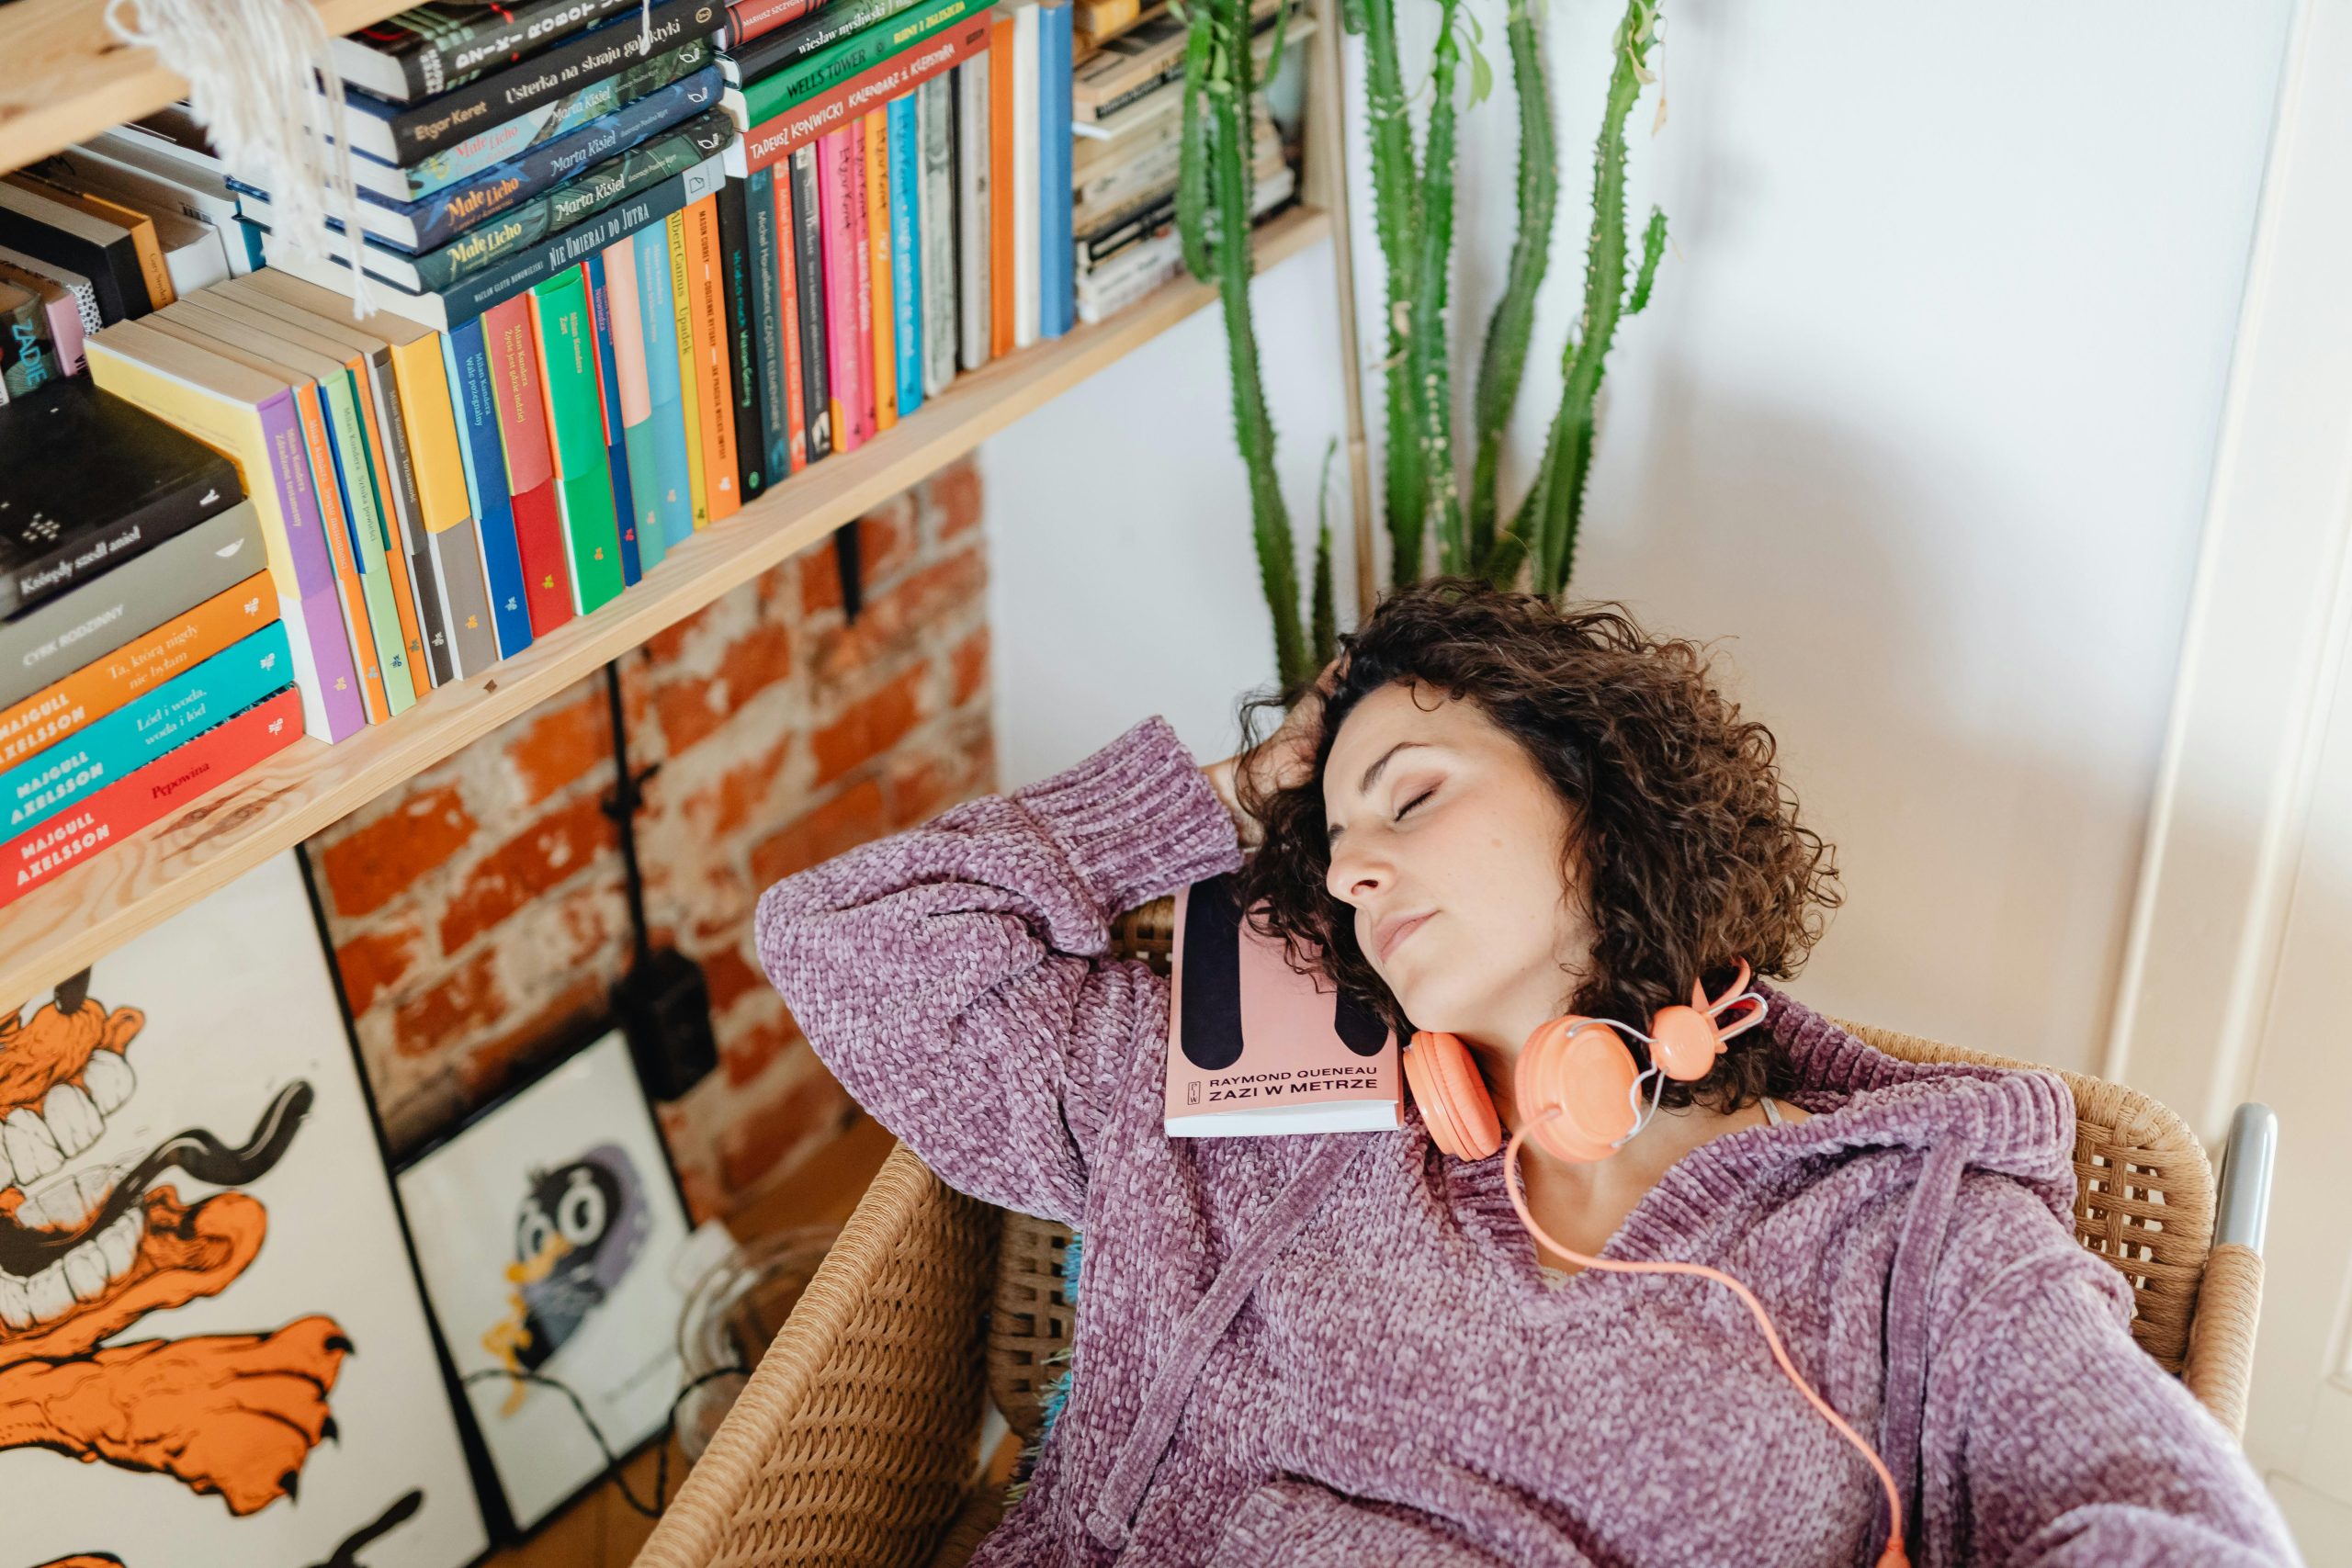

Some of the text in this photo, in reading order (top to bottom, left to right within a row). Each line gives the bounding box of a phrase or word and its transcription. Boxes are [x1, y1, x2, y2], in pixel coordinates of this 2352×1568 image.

[527, 3, 595, 39] ROBOT
[742, 9, 771, 27] MARIUSZ
[505, 74, 559, 104] Usterka
[560, 64, 579, 81] na
[582, 47, 621, 73] skraju
[624, 18, 681, 59] galktyki
[797, 29, 837, 54] wiesław
[786, 48, 867, 99] WELLS TOWER
[414, 100, 488, 141] Etgar Keret
[550, 85, 611, 125] Marta Kisiel
[750, 128, 790, 160] TADEUSZ
[790, 101, 844, 138] KONWICKI
[848, 72, 899, 108] KALENDARZ
[489, 126, 518, 152] Licho
[550, 148, 586, 176] Marta
[588, 130, 616, 157] Kisiel
[486, 177, 519, 207] Licho
[555, 174, 626, 221] Marta Kisiel
[487, 222, 522, 251] Licho
[549, 203, 650, 271] NIE UMIERAJ DO JUTRA
[698, 209, 707, 236] MASON
[758, 210, 769, 247] Michel
[700, 236, 710, 263] CURREY
[671, 210, 692, 355] Albert Camus Upadek
[704, 280, 715, 318] CODZIENNE
[11, 317, 48, 387] ZADIE
[466, 356, 475, 378] Walc
[514, 324, 528, 387] Milan Kundera
[475, 352, 492, 416] Milan Kundera
[508, 369, 519, 392] gdzie
[514, 393, 526, 423] indziej
[343, 407, 361, 470] Milan Kundera
[394, 416, 406, 454] Kundera
[166, 622, 198, 656] nigdy
[144, 719, 177, 746] woda
[178, 714, 186, 730] i
[164, 703, 172, 719] i
[10, 761, 104, 825] AXELSSON
[17, 750, 89, 800] MAJGULL
[151, 761, 210, 801] Pępowina
[17, 824, 110, 886] AXELSSON
[21, 812, 96, 861] MAJGULL
[1209, 1066, 1377, 1087] RAYMOND QUENEAU
[1209, 1078, 1378, 1101] ZAZI W METRZE
